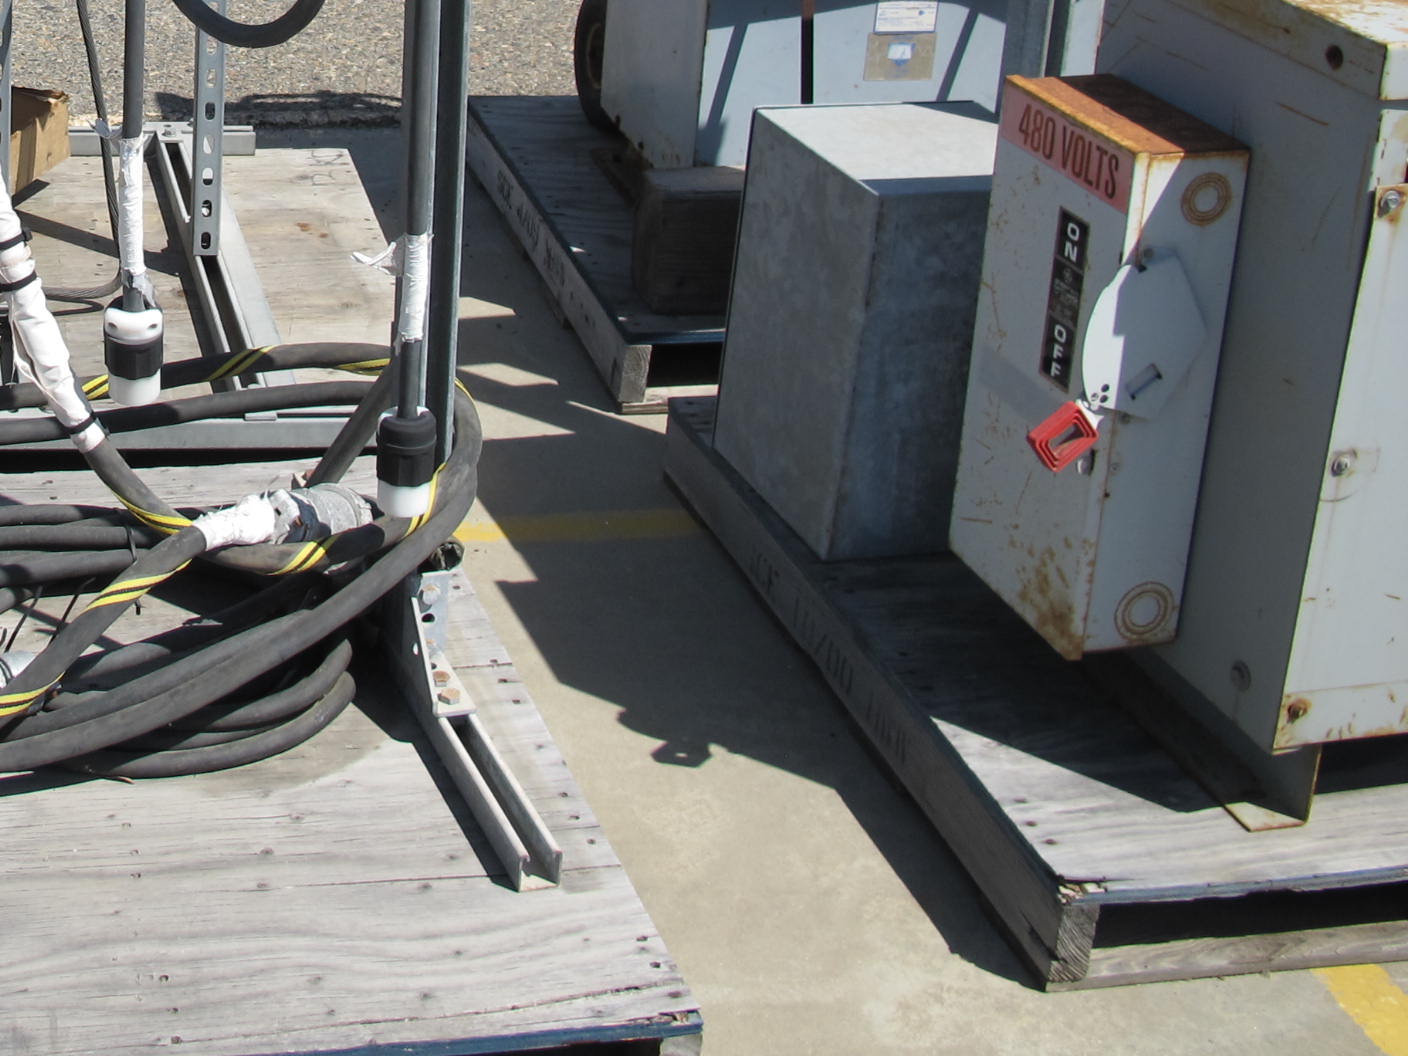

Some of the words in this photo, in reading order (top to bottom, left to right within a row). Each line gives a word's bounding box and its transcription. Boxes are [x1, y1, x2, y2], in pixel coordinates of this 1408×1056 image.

[1018, 103, 1057, 161] 480
[1061, 124, 1120, 201] VOLTS
[1063, 222, 1080, 264] ON
[1050, 323, 1067, 378] OFF
